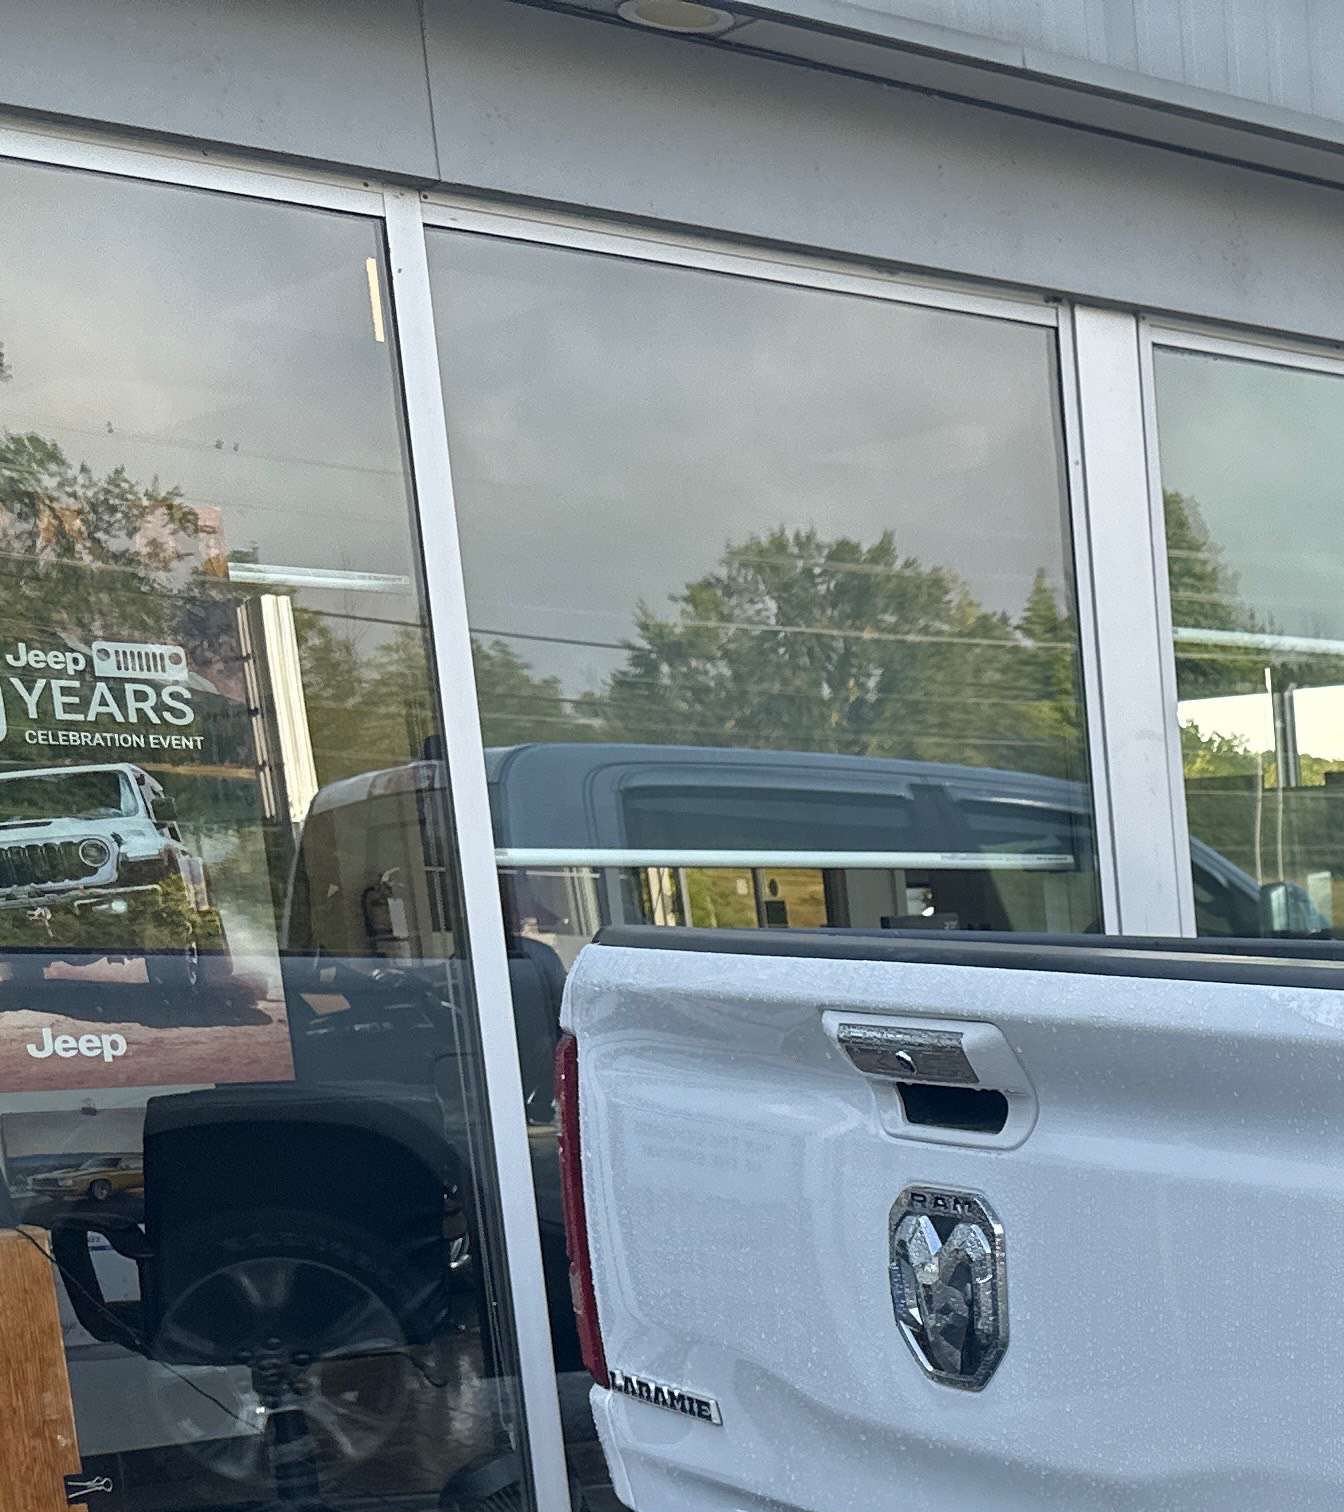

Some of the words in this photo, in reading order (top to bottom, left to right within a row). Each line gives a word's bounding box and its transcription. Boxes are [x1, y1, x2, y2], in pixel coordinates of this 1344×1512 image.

[5, 642, 86, 675] Jeep
[9, 677, 195, 726] YEARS
[25, 730, 145, 748] CELEBRATION
[150, 734, 204, 750] EVENT
[26, 1027, 127, 1062] Jeep
[911, 1192, 976, 1216] RAM
[609, 1369, 715, 1422] LARAMIE
